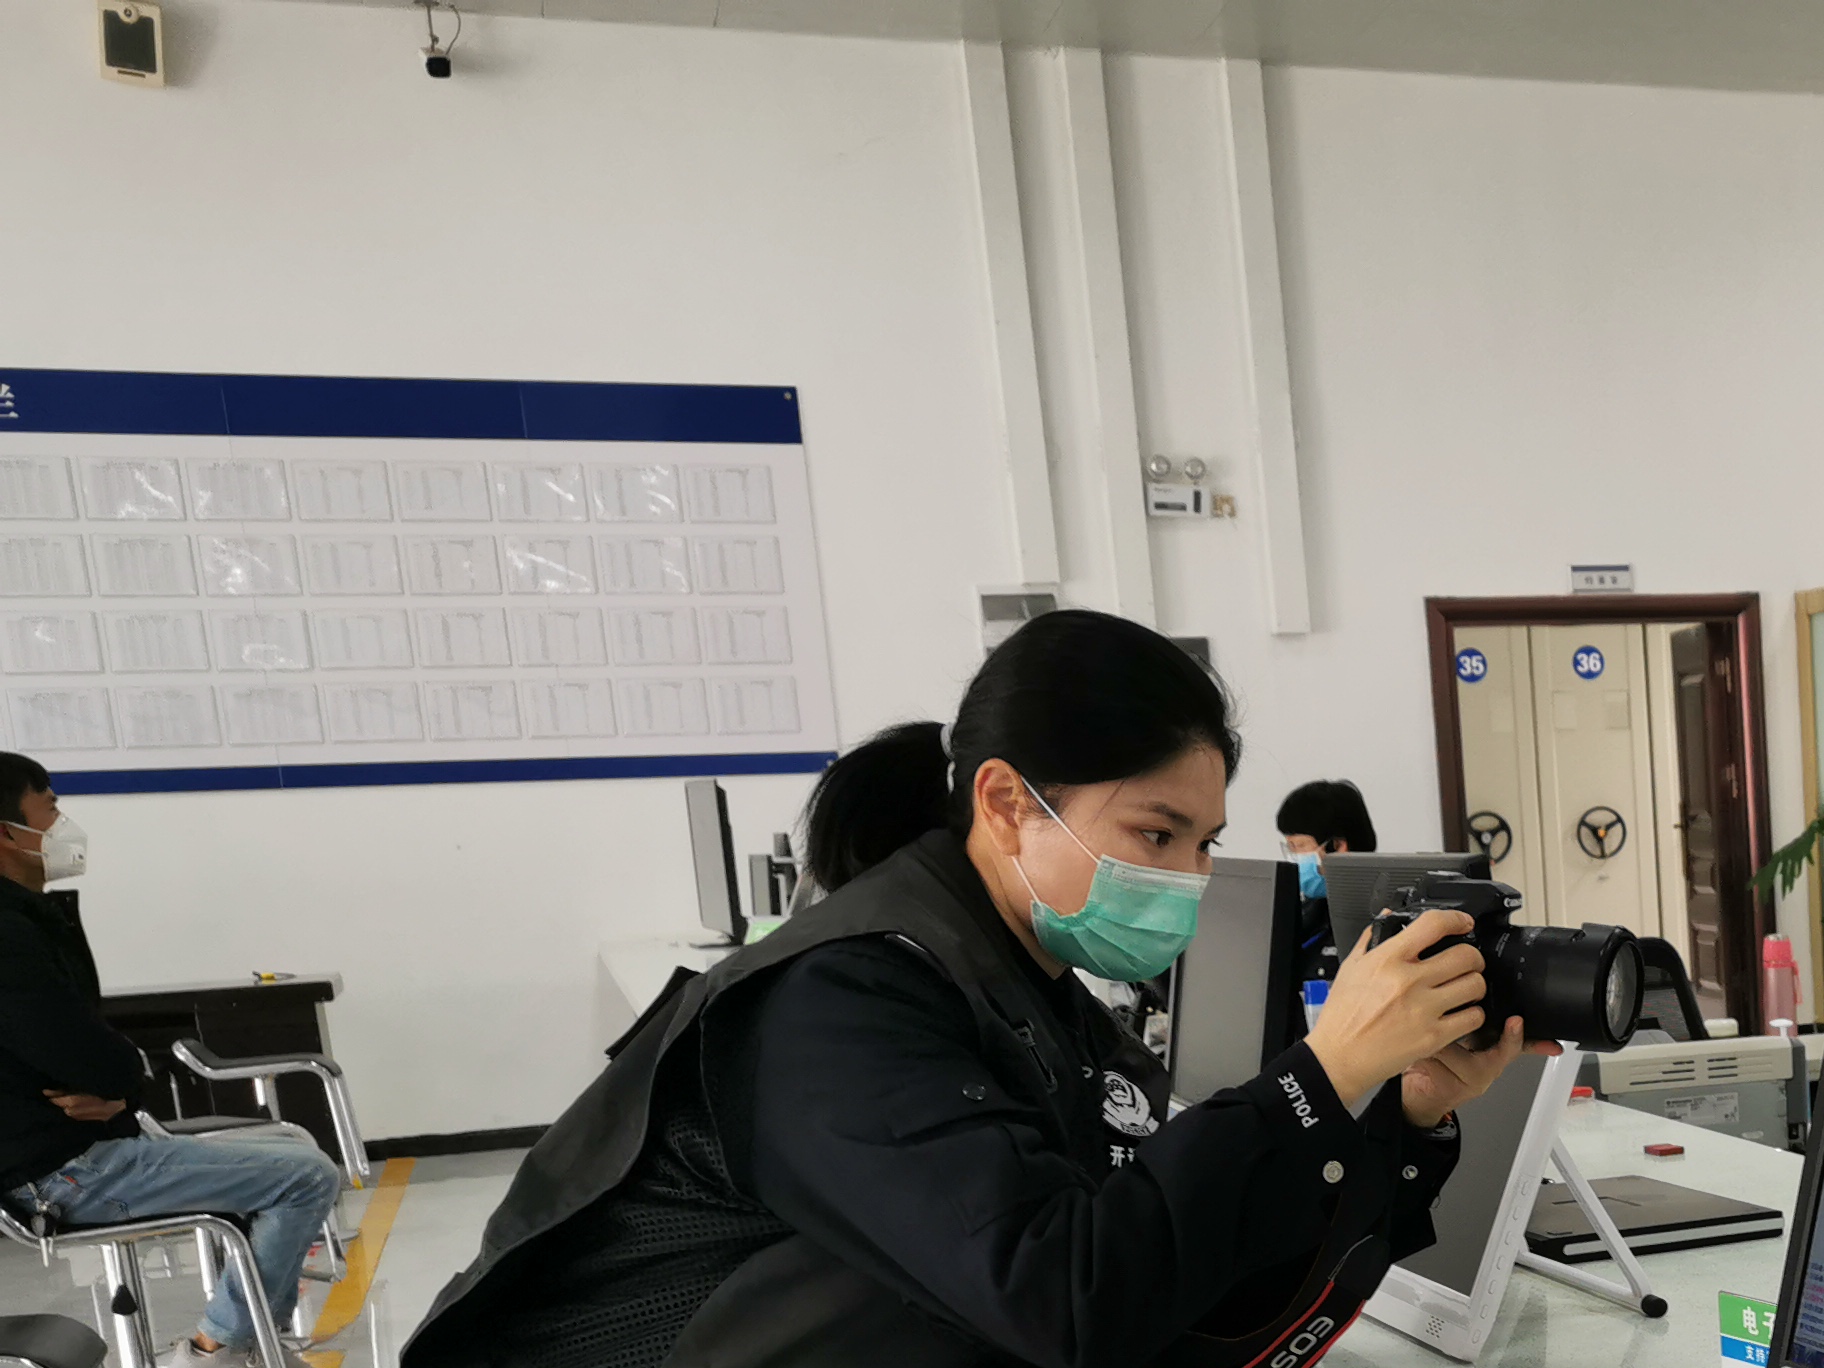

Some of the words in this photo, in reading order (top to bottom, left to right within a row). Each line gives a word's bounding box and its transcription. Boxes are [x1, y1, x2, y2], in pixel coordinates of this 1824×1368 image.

[1459, 655, 1484, 677] 35
[1576, 652, 1602, 673] 36
[1277, 1071, 1320, 1129] POLICE
